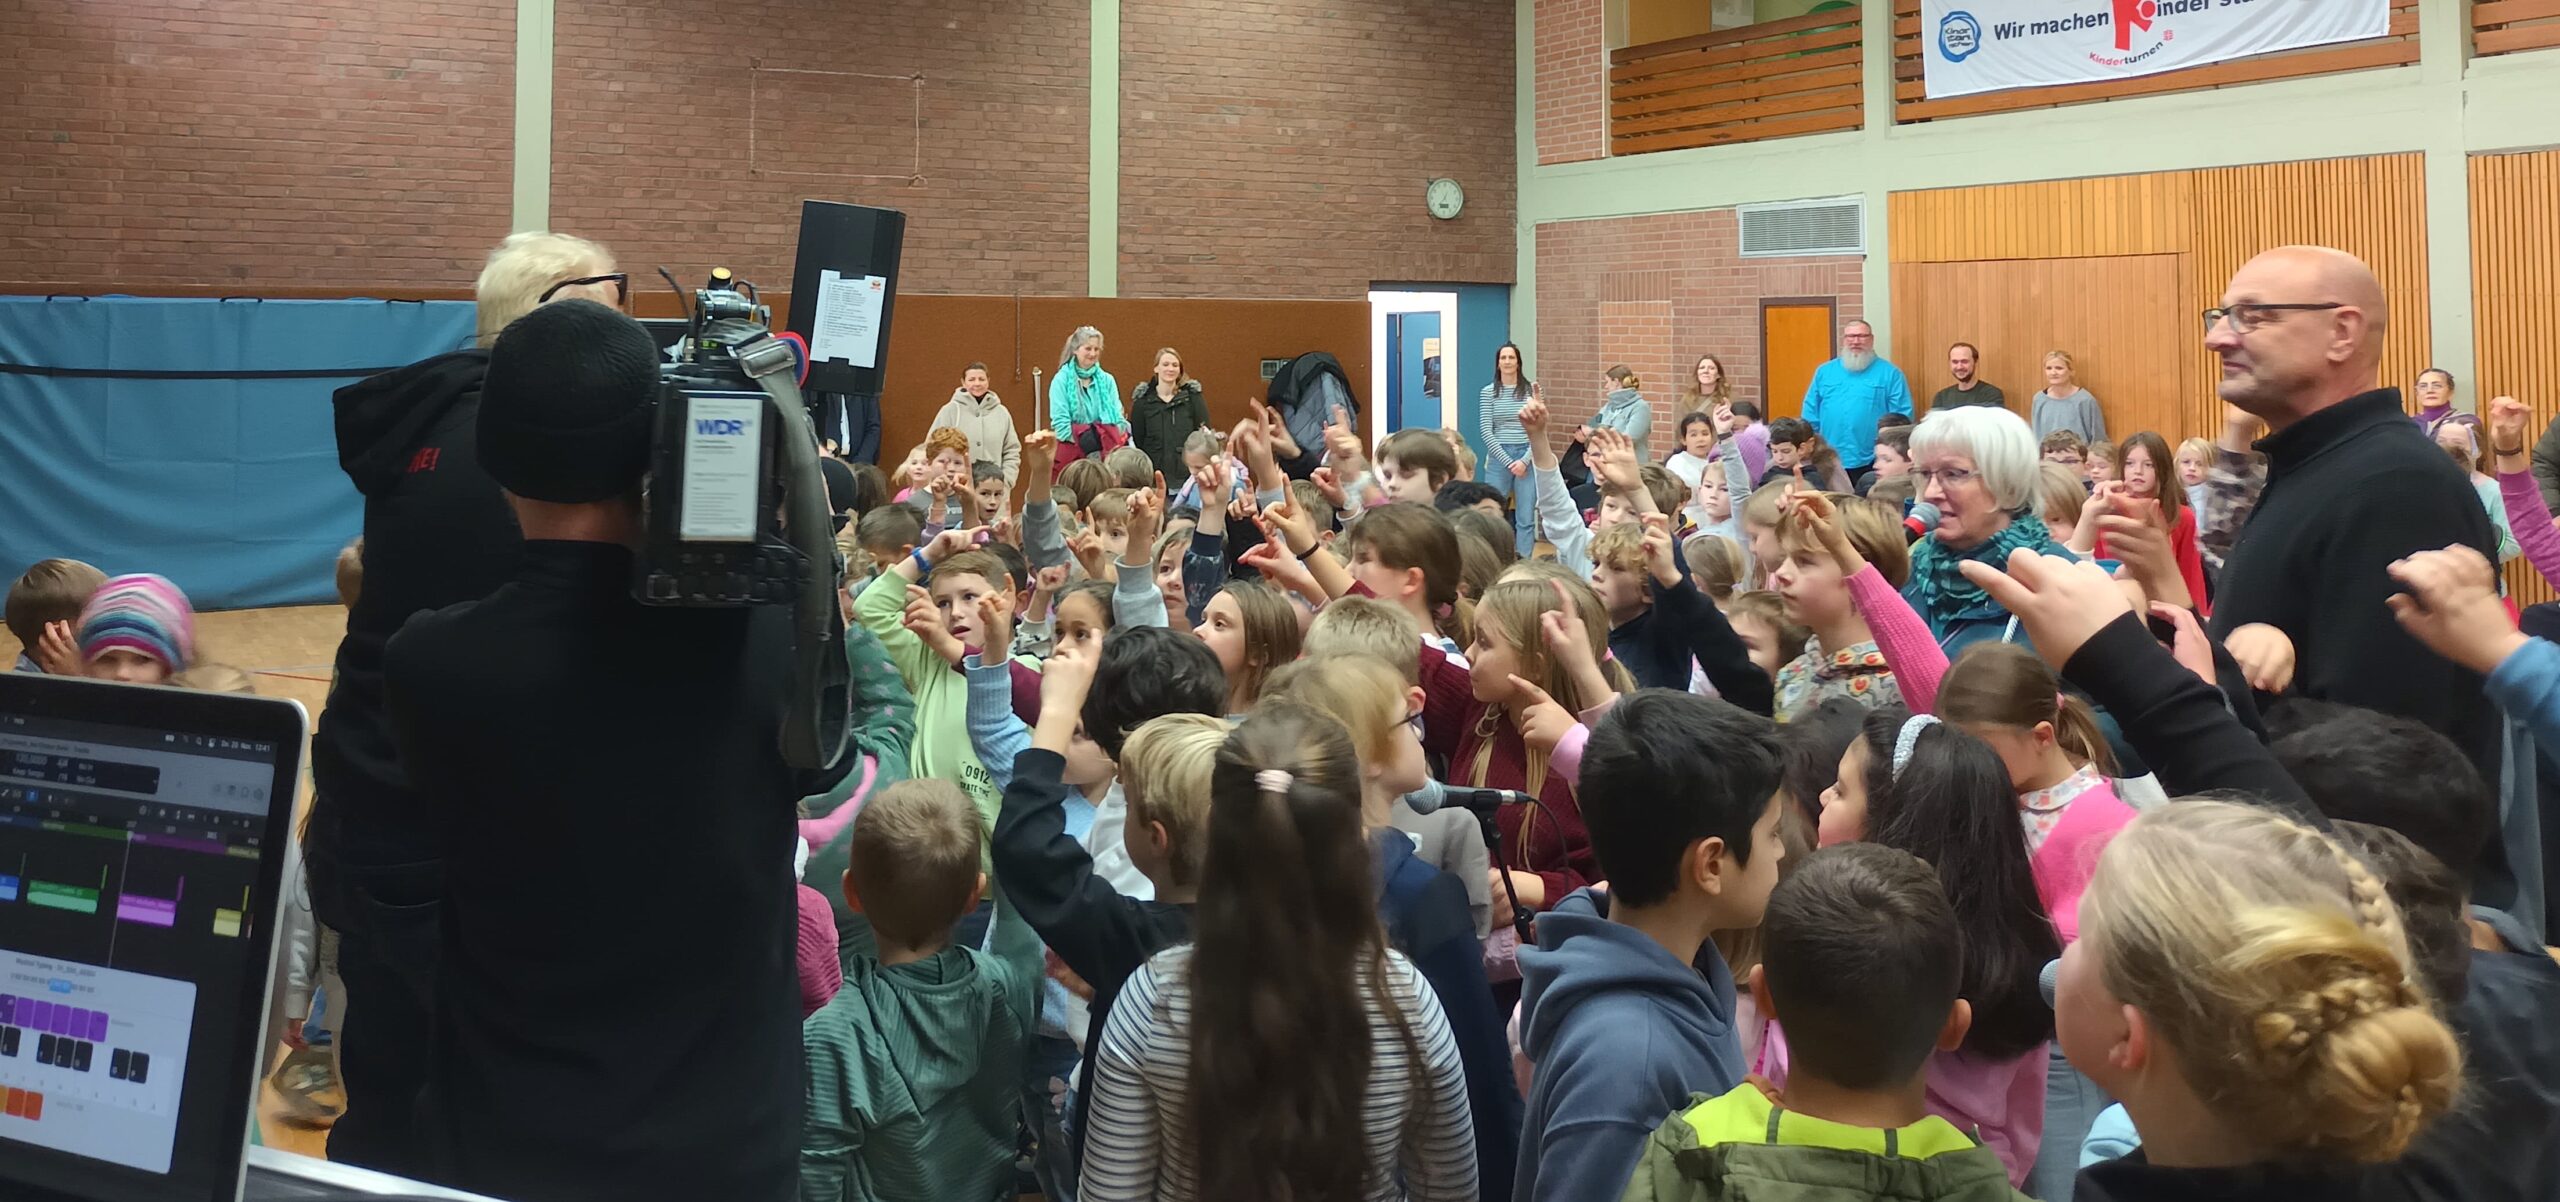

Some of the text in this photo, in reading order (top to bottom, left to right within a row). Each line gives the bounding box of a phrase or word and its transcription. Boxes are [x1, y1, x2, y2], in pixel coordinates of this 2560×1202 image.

[1994, 21, 2025, 41] Wir
[2030, 12, 2109, 36] machen
[2089, 41, 2163, 66] Kinderturnen
[696, 418, 745, 436] WDR
